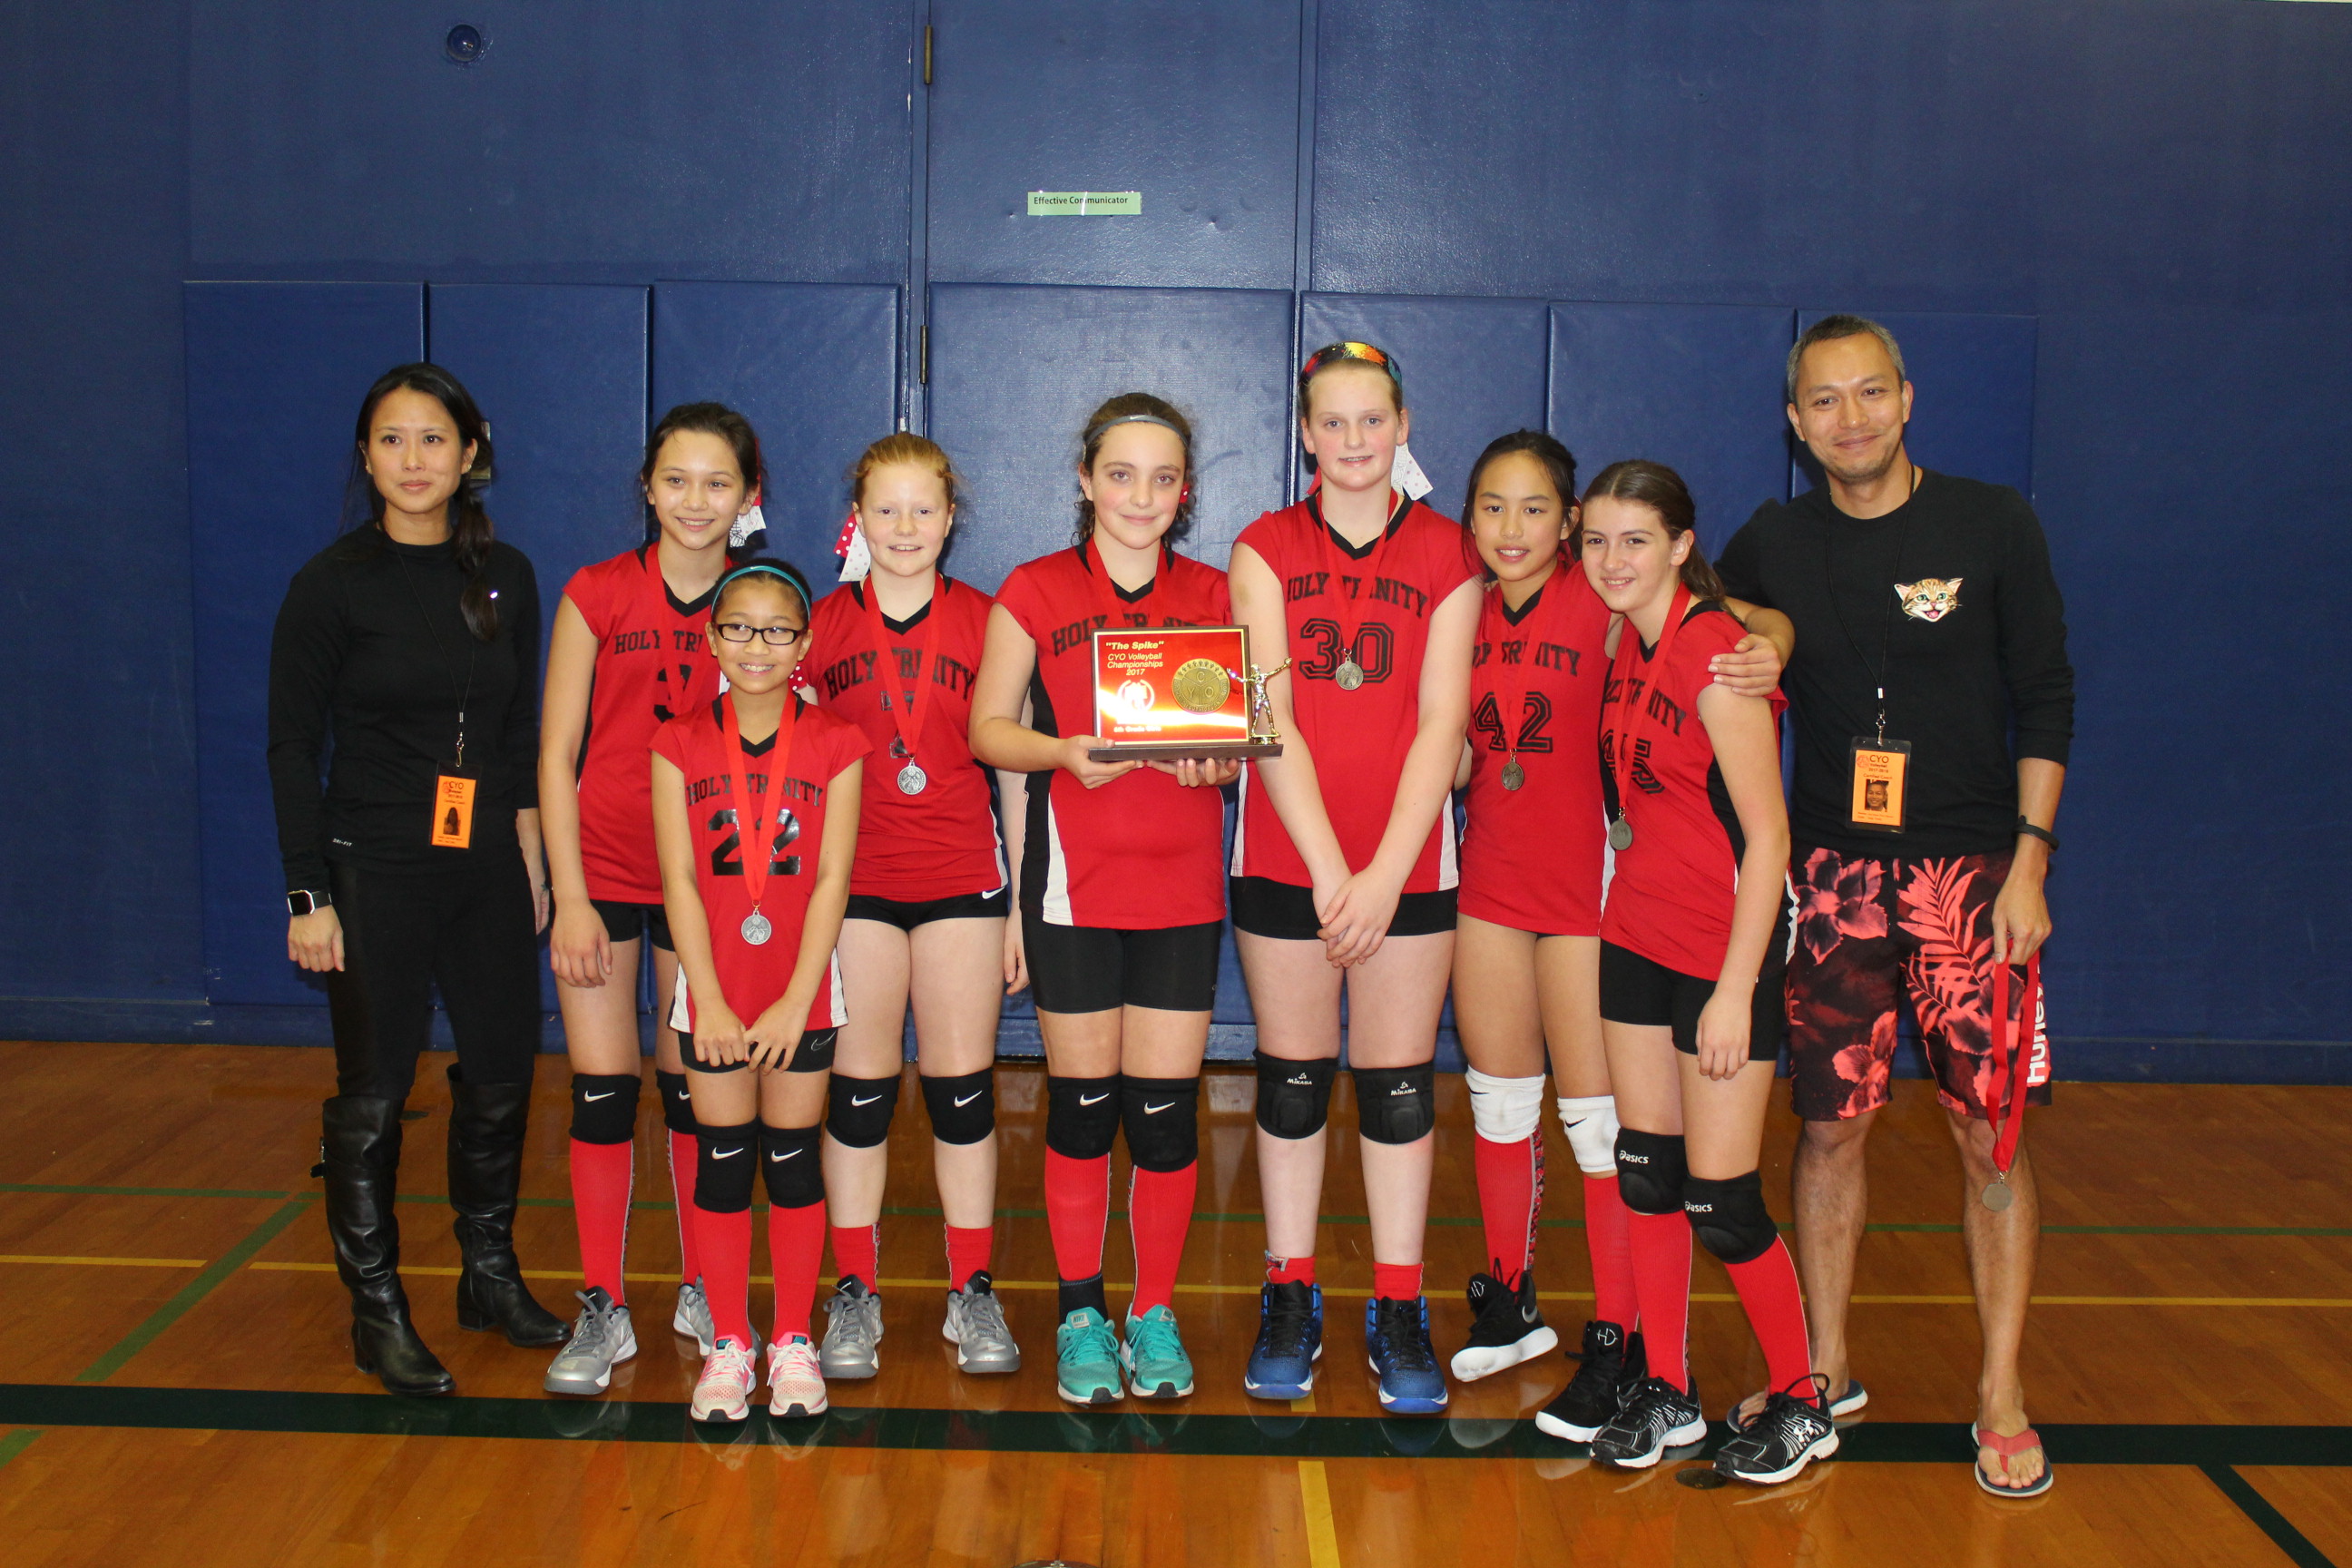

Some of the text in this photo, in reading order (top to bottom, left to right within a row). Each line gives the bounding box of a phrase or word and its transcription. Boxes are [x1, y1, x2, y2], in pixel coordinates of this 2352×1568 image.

[1034, 196, 1129, 205] Effective Communicator
[614, 630, 661, 655] HOLY
[1051, 614, 1108, 657] HOLY
[1105, 640, 1165, 651] "The Spike"
[1298, 618, 1394, 683] 30
[1107, 652, 1163, 662] CYO Volleyball
[1107, 660, 1163, 670] Championships
[823, 650, 878, 702] HOLY
[1125, 668, 1146, 676] 2017
[1474, 691, 1553, 753] 42
[1869, 754, 1889, 764] CYO
[448, 780, 465, 790] CYO
[687, 773, 823, 807] HOLY TRNITY
[708, 808, 800, 876] 22
